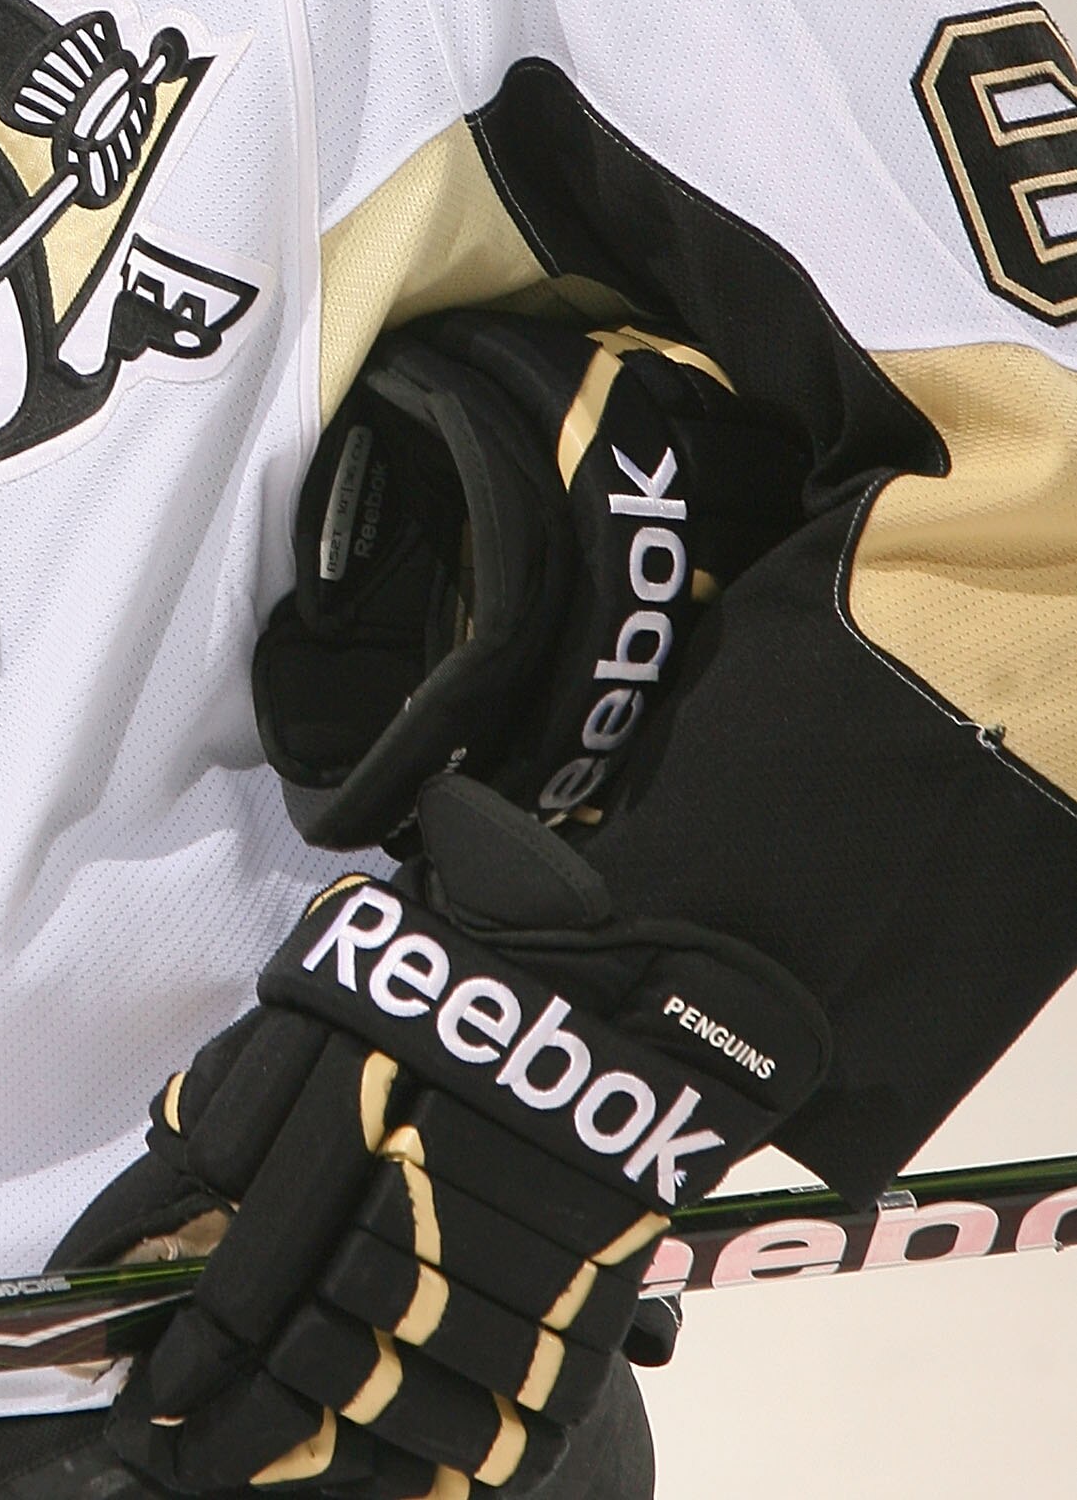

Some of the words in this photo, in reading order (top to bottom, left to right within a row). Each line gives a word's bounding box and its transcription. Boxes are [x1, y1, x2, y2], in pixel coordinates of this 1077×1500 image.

[539, 443, 688, 809] eebok
[302, 886, 725, 1206] Reebok
[663, 995, 777, 1080] PENGUINS
